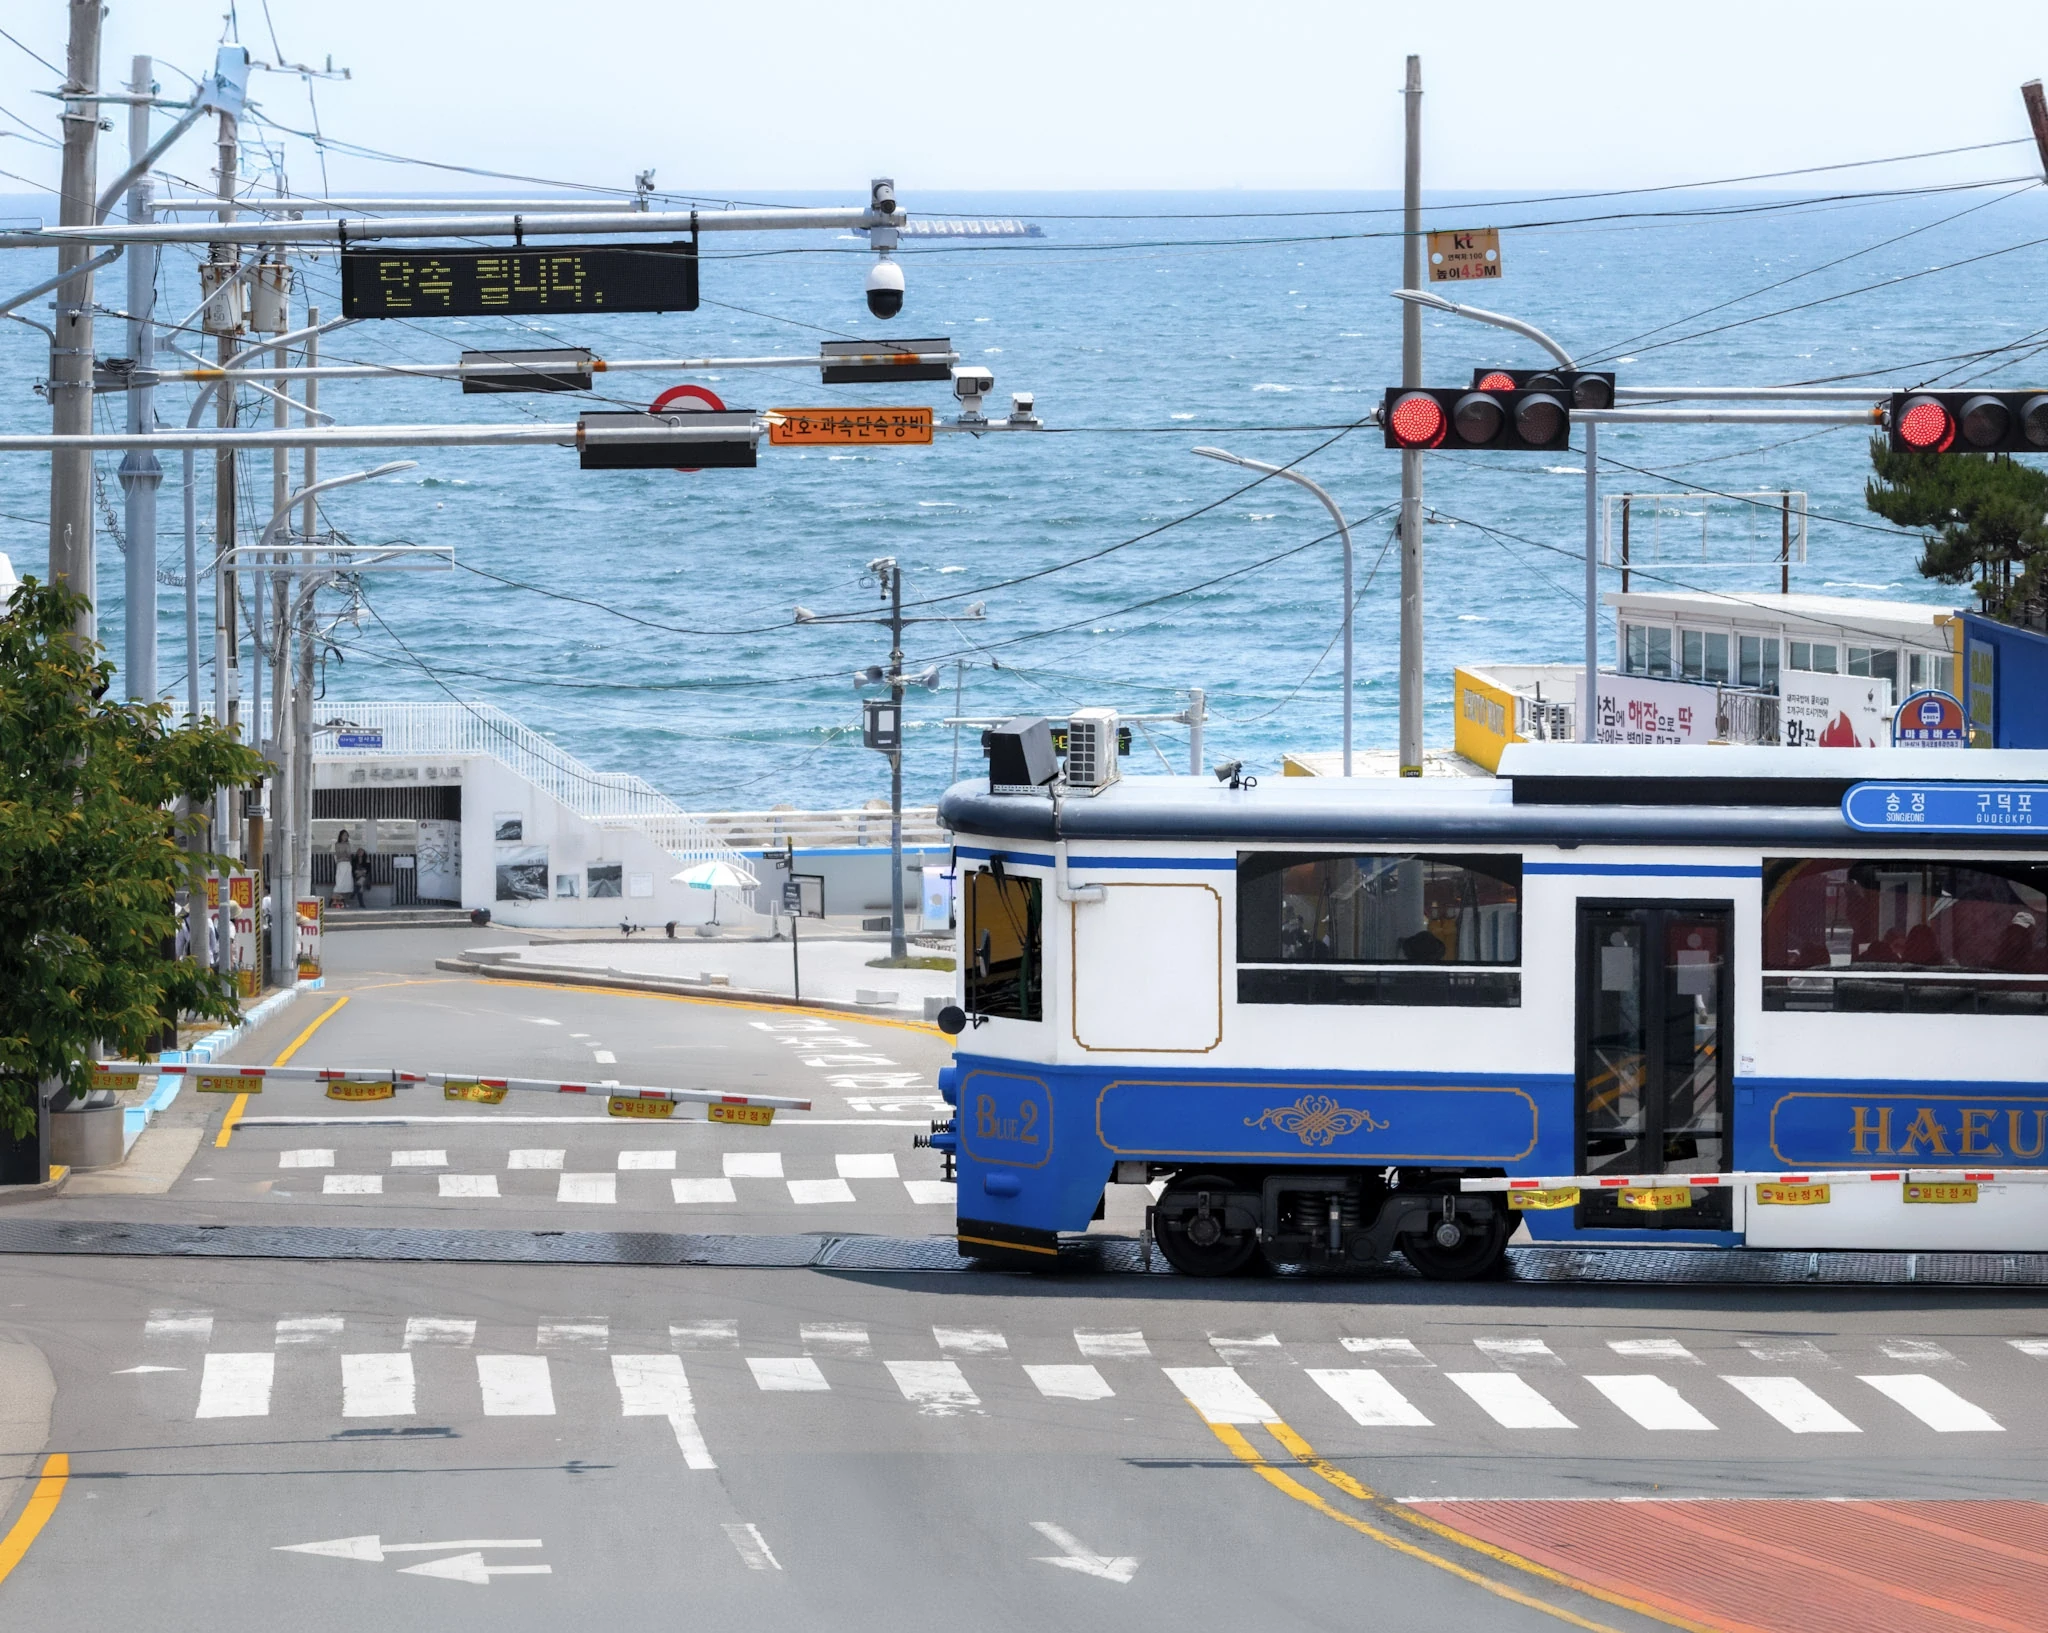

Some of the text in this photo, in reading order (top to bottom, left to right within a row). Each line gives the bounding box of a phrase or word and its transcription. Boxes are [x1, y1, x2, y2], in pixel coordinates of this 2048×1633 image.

[1454, 233, 1474, 249] kt
[1678, 706, 1693, 736] 딱
[1905, 729, 1957, 739] 마을버스
[1886, 793, 2032, 812] 송정 구덕포
[1886, 812, 2032, 824] SONGJEONG GUDEOKPO
[625, 1101, 669, 1114] 일단정지
[726, 1109, 770, 1121] 일단정지
[1775, 1188, 1824, 1201] 일단정지
[1922, 1187, 1972, 1198] 일단정지
[1636, 1193, 1685, 1206] 일단정지
